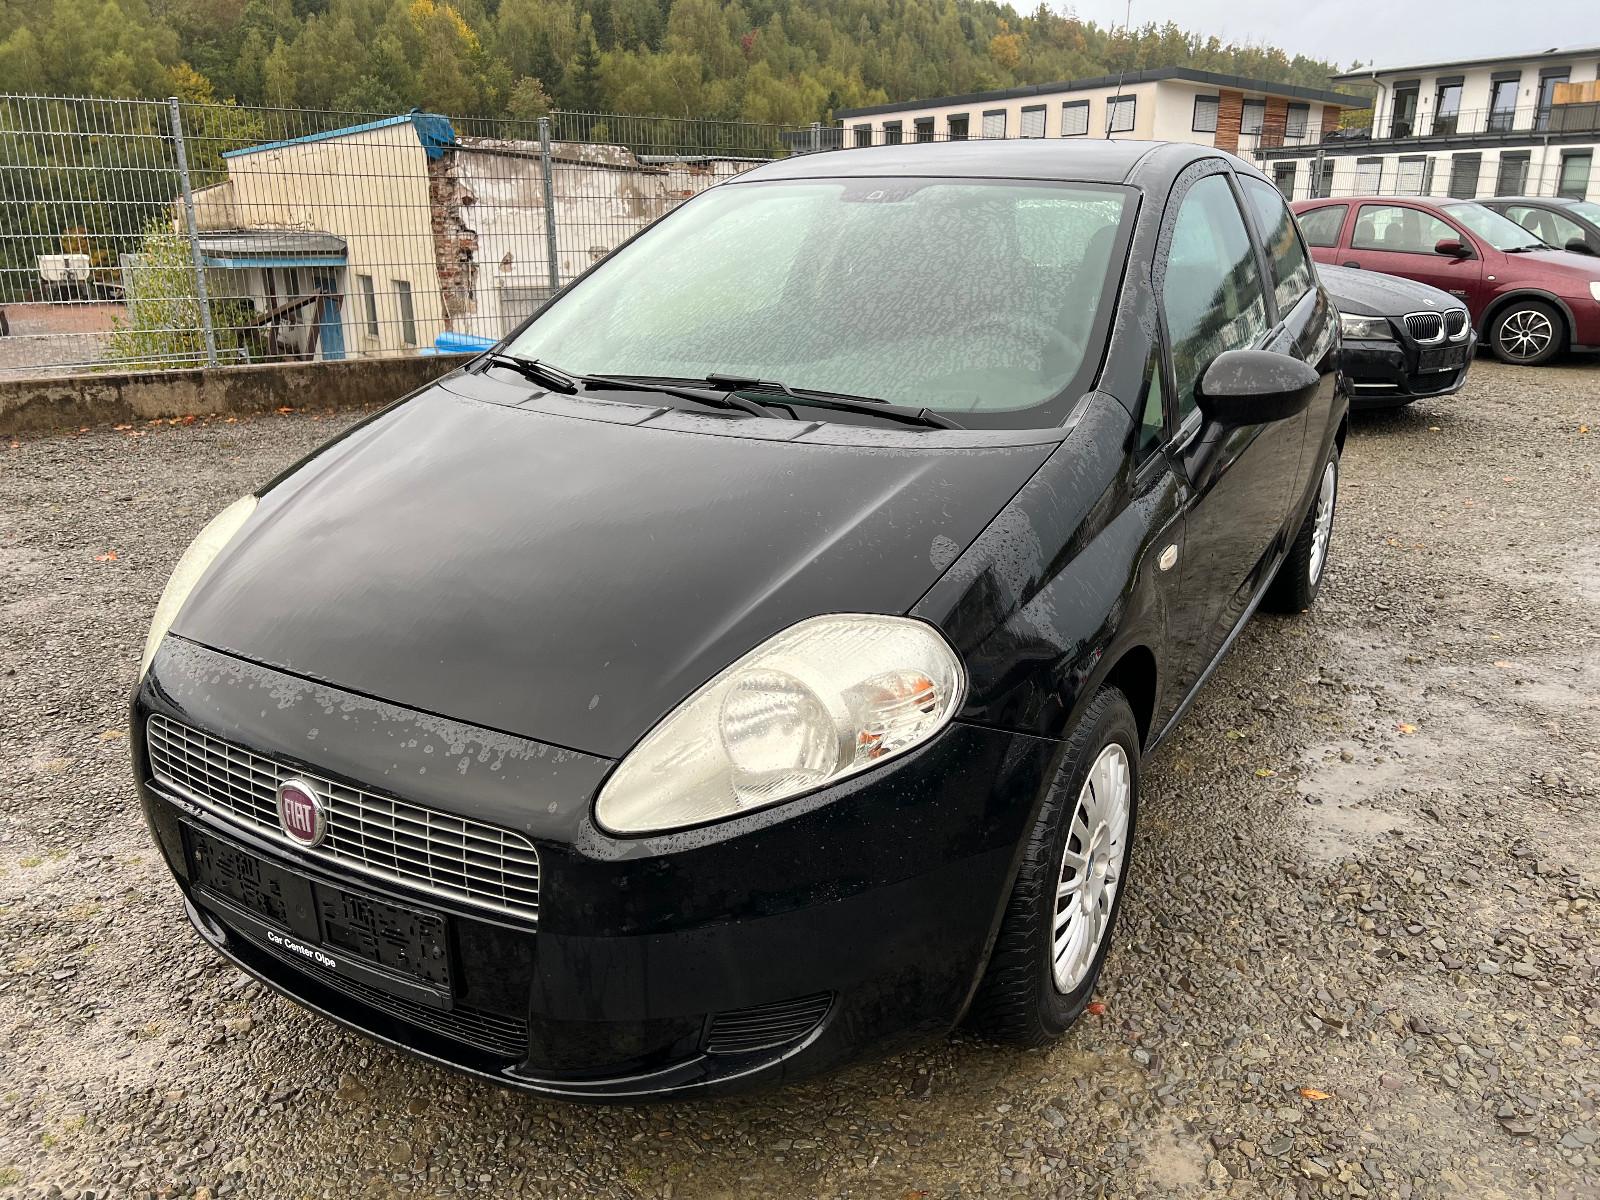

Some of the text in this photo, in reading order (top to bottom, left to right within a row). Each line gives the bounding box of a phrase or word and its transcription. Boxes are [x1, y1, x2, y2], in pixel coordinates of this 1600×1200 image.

[284, 798, 312, 833] FIAT
[267, 931, 337, 968] Car Center Olpe
